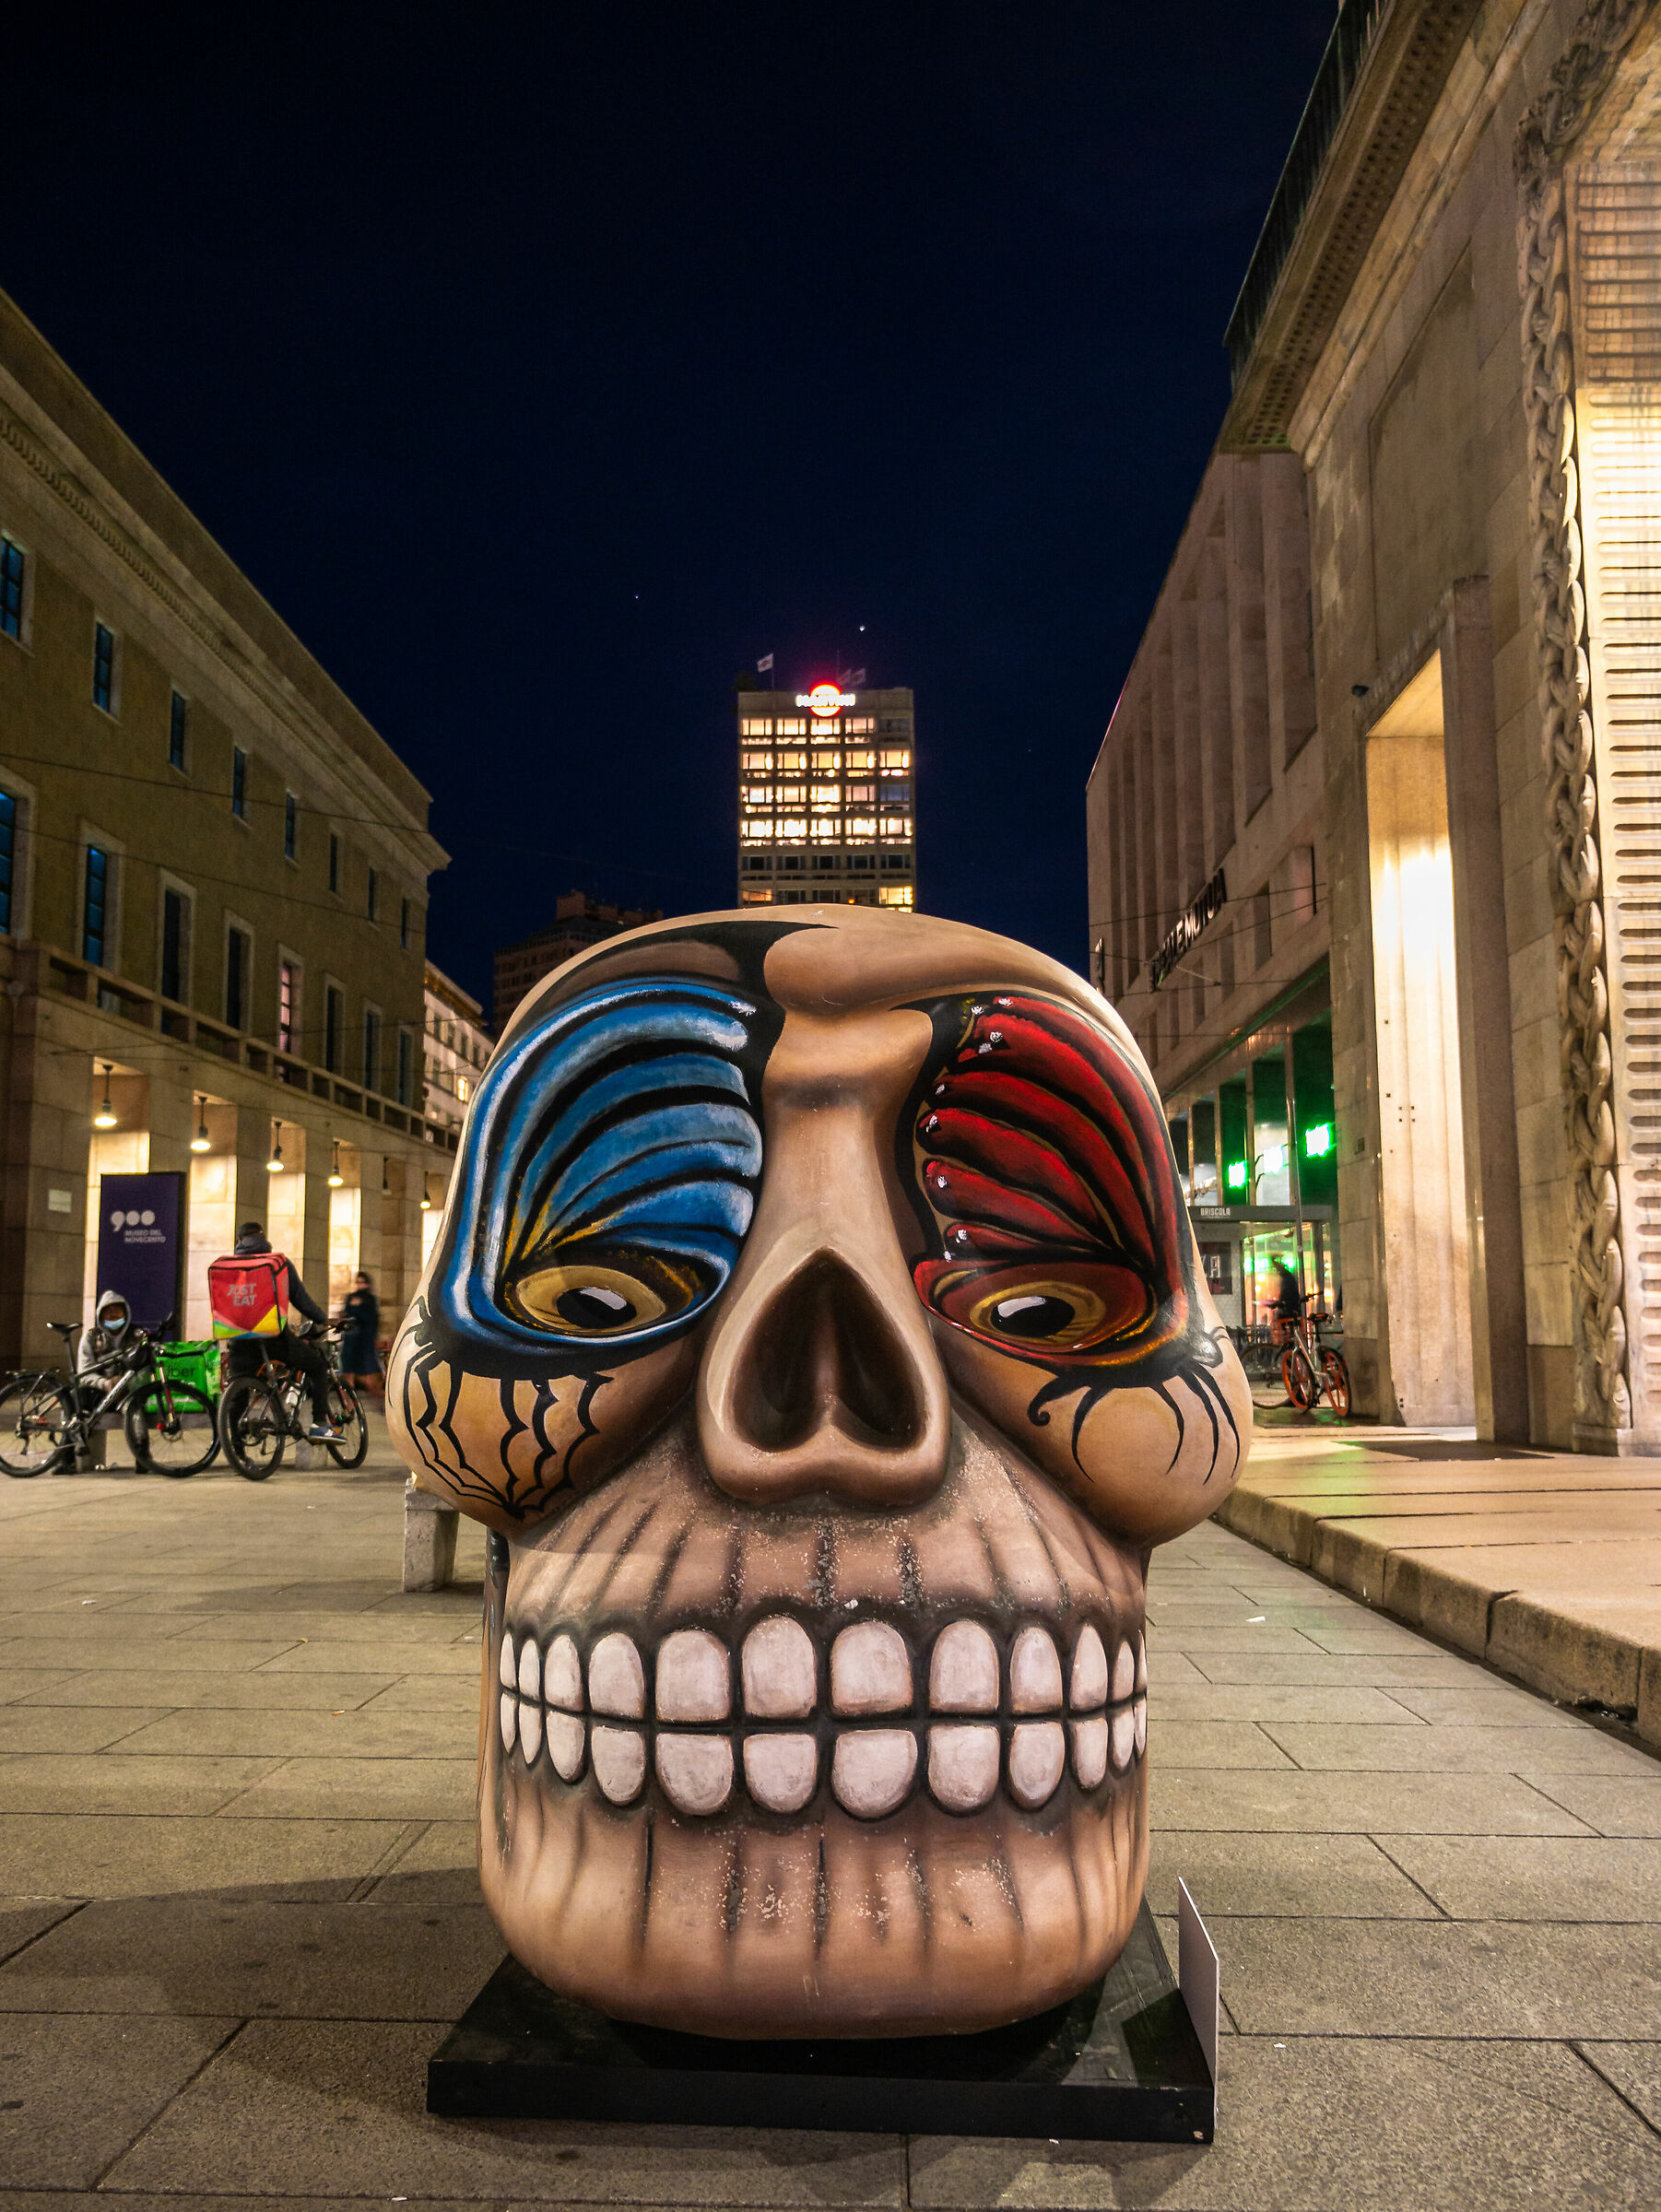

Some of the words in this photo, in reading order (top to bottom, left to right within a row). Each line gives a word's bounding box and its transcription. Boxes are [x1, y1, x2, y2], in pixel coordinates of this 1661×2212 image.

[1200, 1207, 1231, 1217] BRISCOLA
[227, 1283, 257, 1297] JUST
[232, 1295, 257, 1306] EAT
